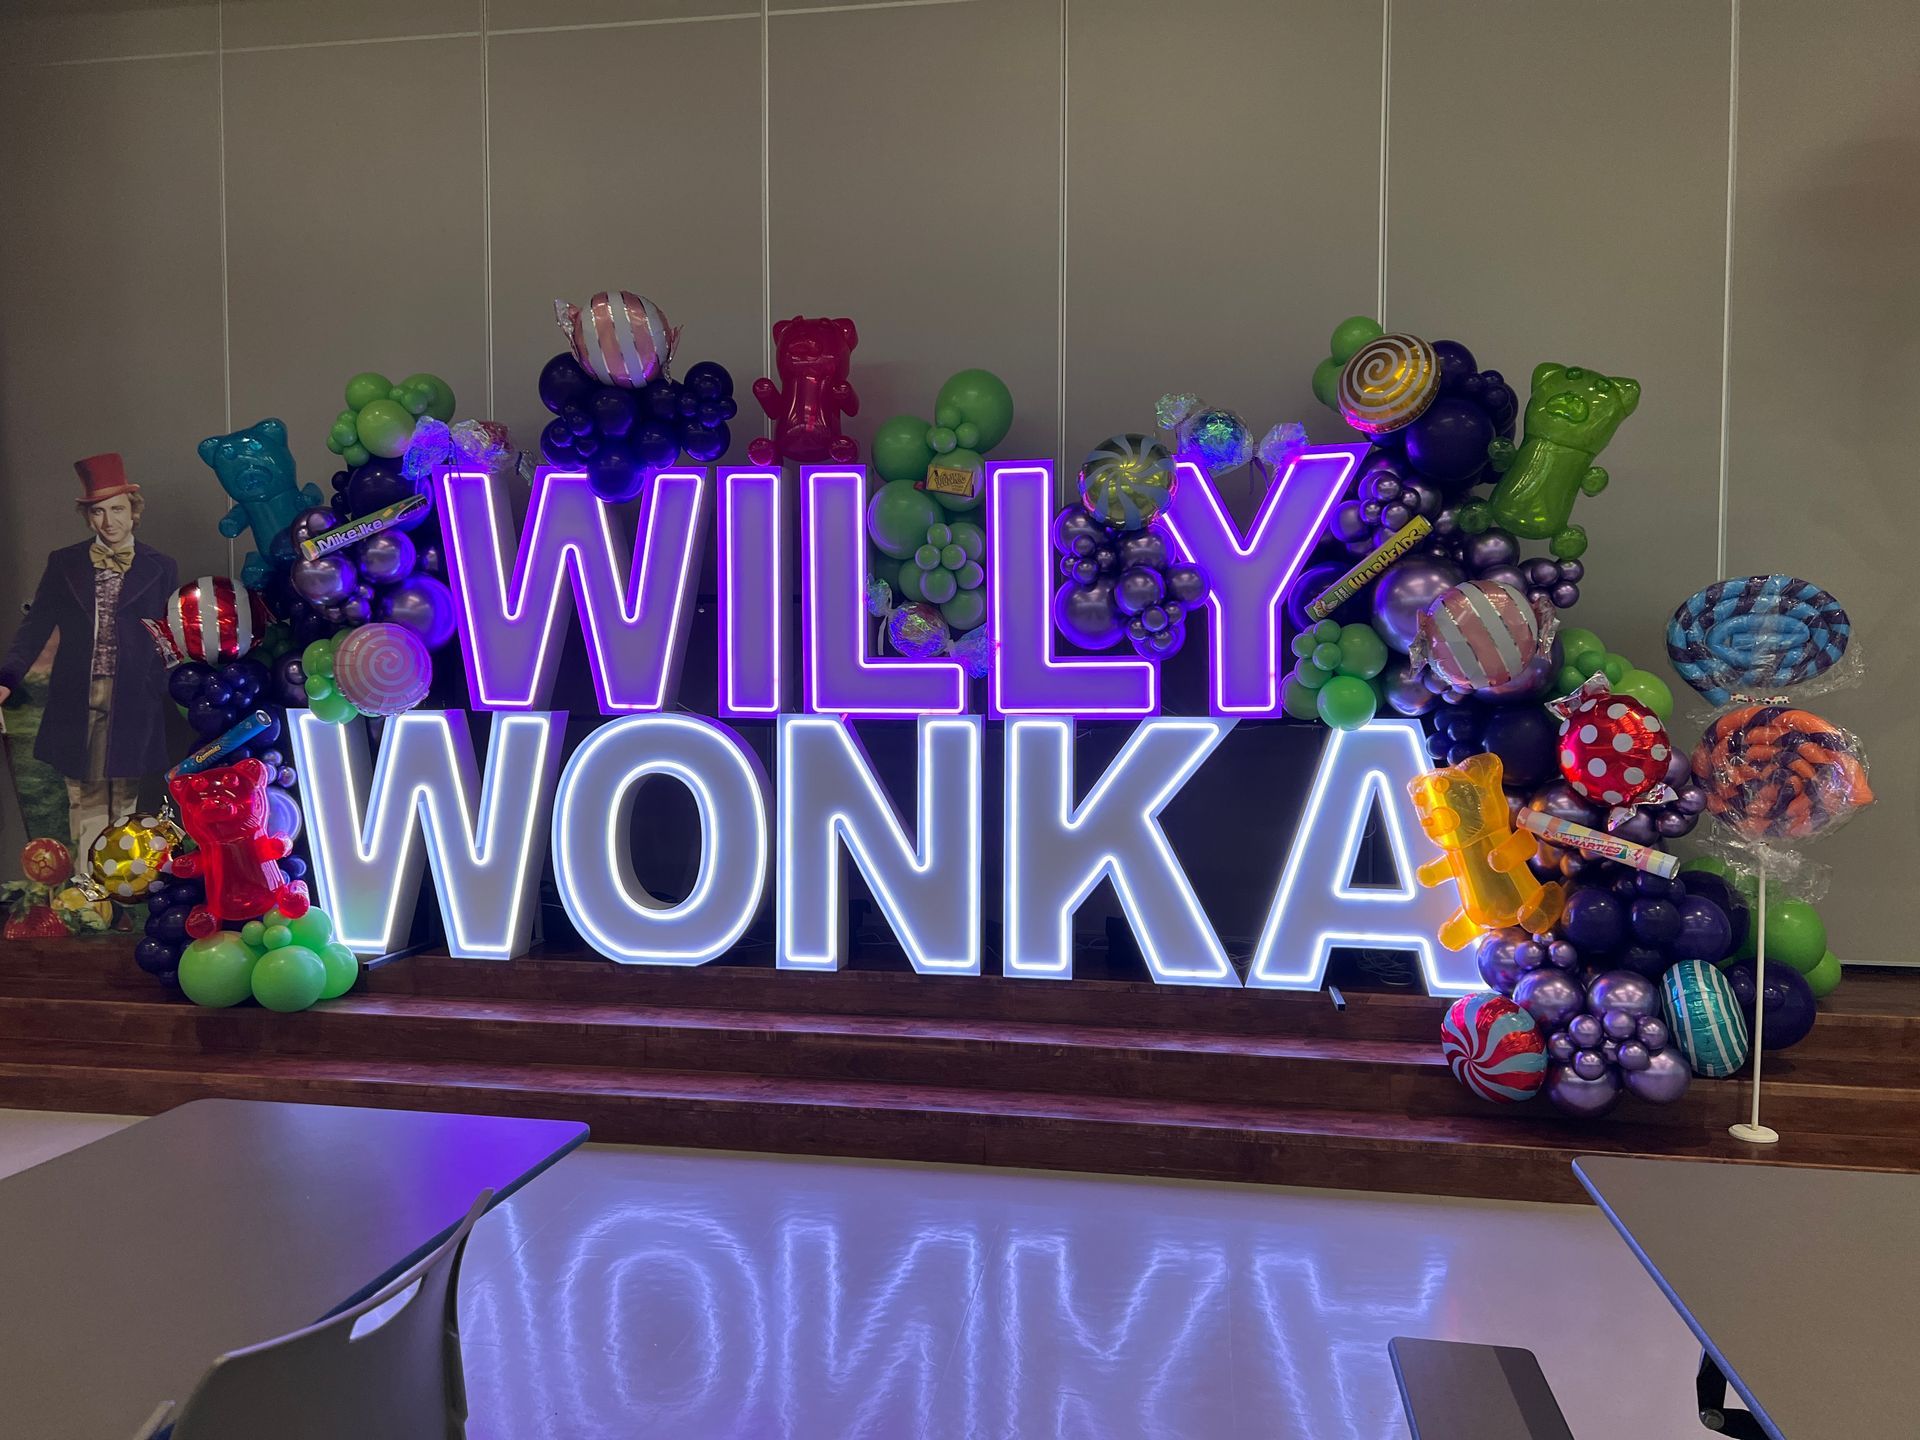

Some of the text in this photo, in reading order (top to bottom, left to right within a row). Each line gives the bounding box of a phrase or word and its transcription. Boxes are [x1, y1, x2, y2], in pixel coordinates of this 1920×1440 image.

[316, 519, 383, 552] Mike Ike
[432, 442, 1369, 718] WILLY
[287, 709, 1490, 995] WONKA
[1561, 836, 1623, 855] SMARTIES
